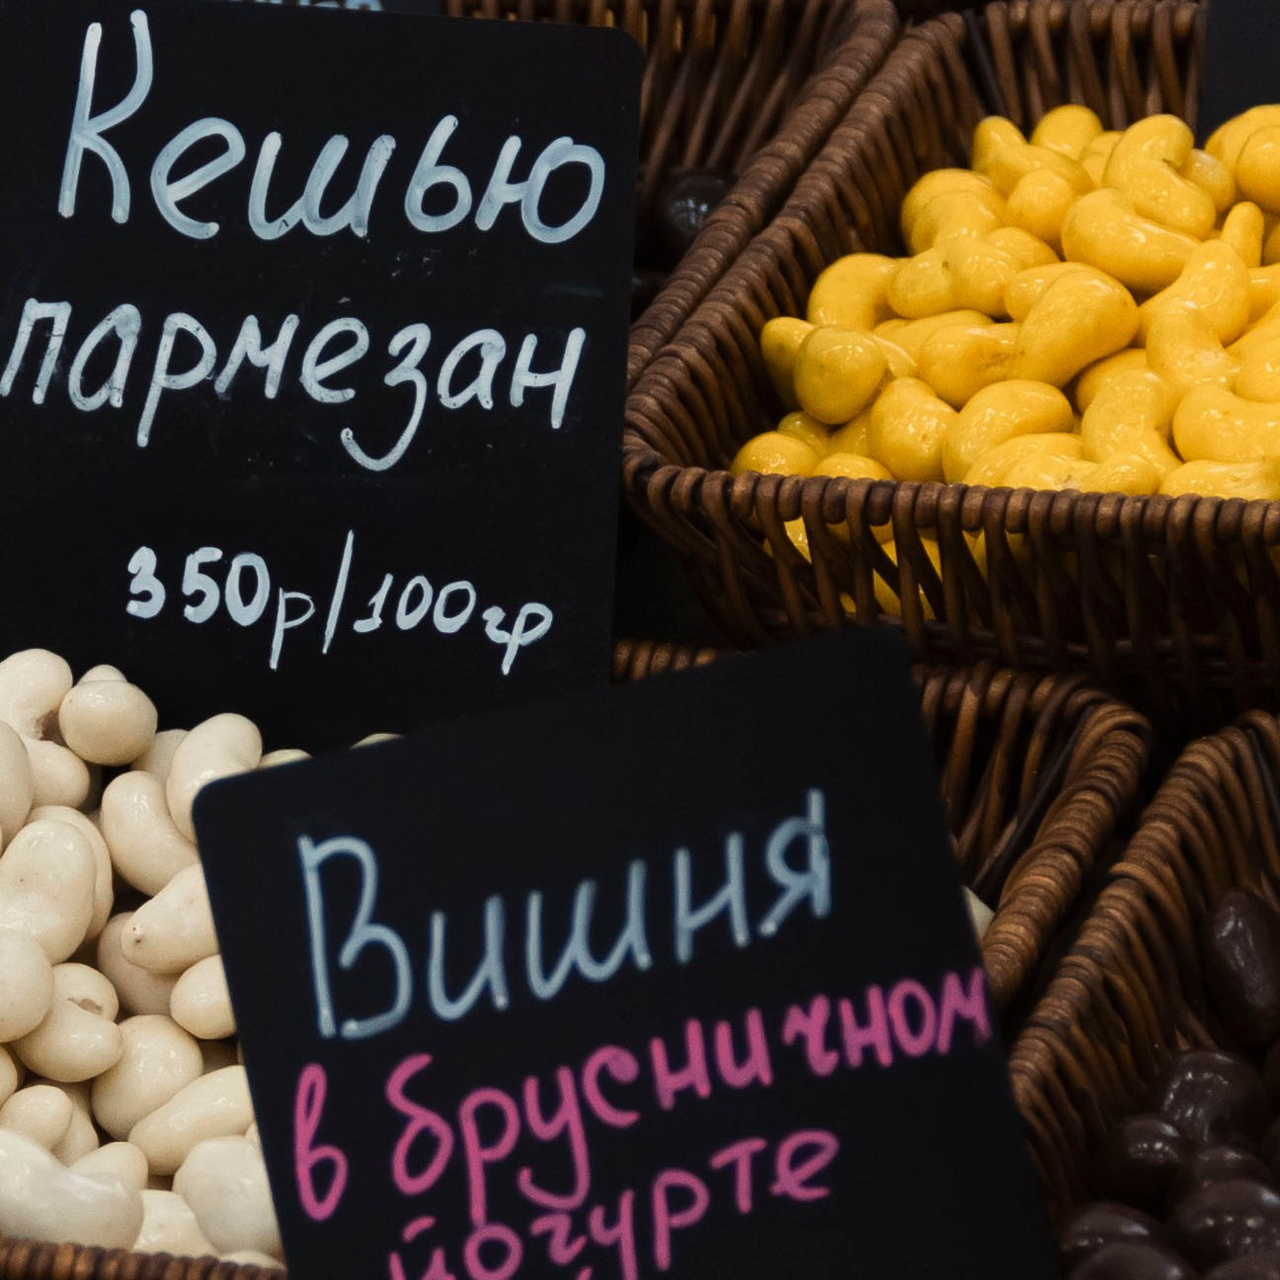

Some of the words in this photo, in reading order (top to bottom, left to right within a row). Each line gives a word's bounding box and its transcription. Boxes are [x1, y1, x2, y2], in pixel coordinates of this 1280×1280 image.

[57, 9, 607, 245] Кешью
[125, 529, 554, 677] 350р/100гр
[296, 788, 833, 1040] Вишня
[292, 1063, 350, 1221] в
[383, 968, 995, 1227] брусничном
